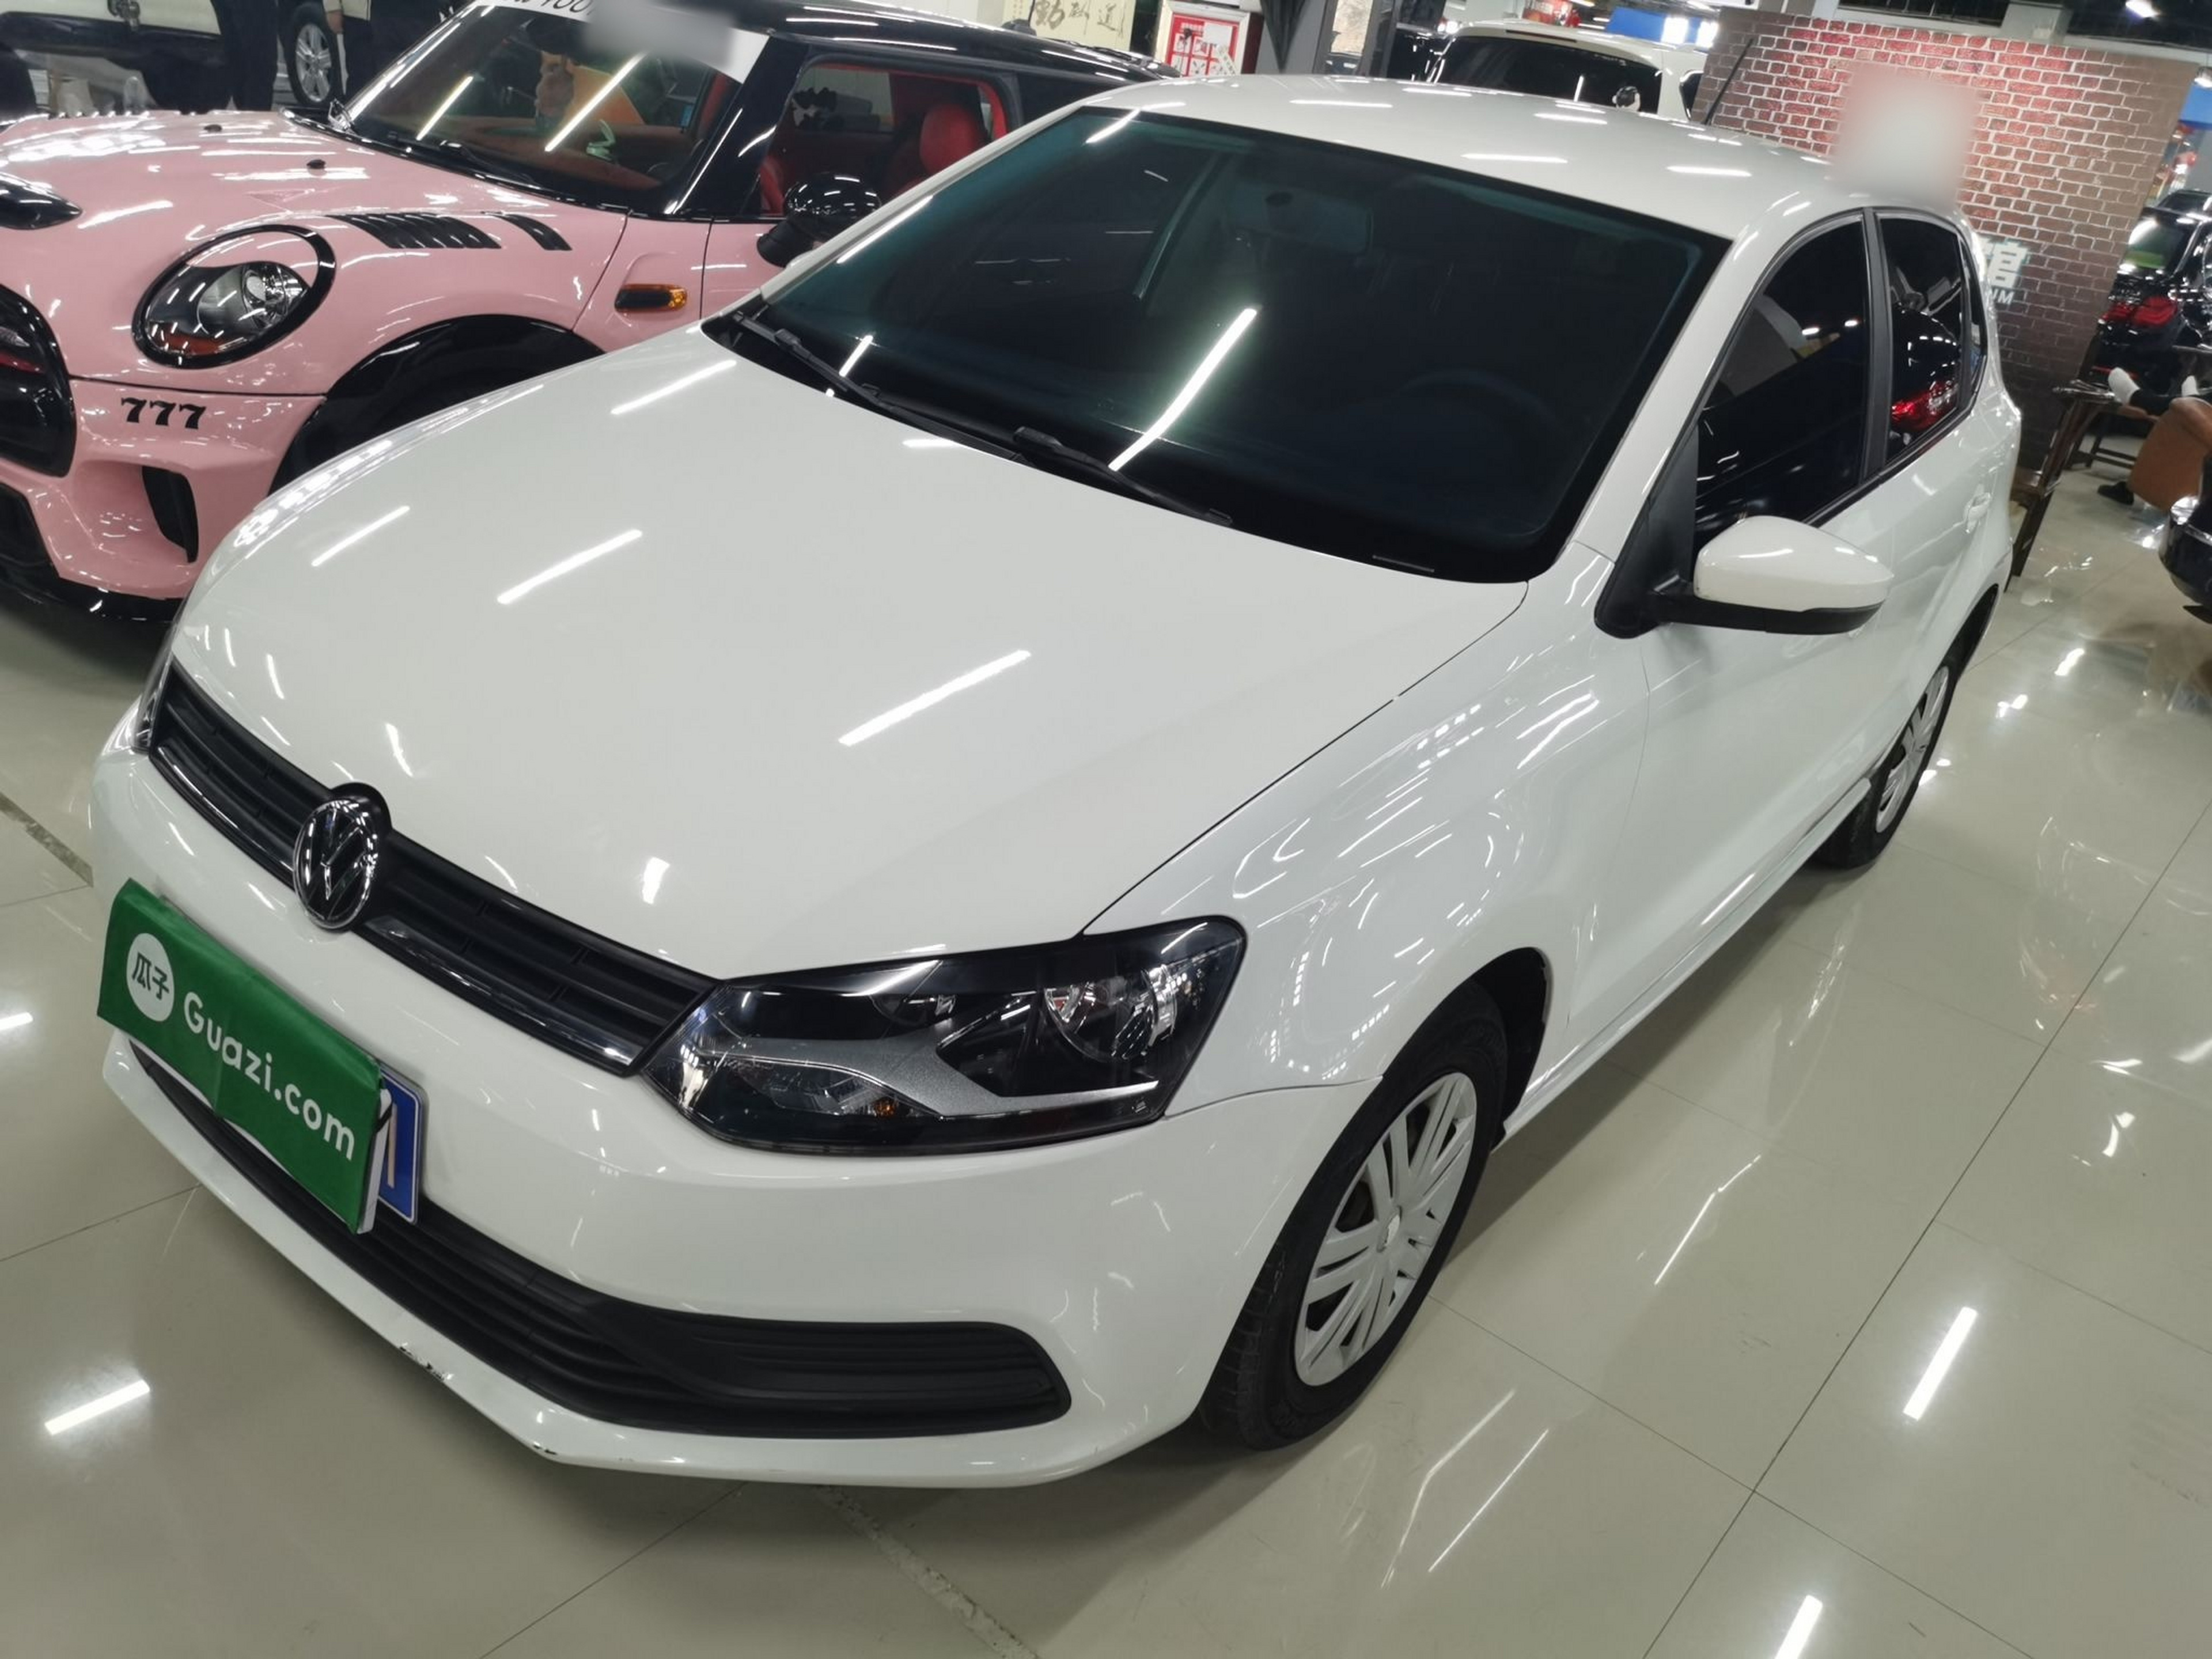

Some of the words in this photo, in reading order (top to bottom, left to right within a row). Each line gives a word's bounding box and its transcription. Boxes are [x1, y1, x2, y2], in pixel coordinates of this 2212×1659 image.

[120, 397, 206, 430] 777
[131, 951, 170, 1001] 瓜子
[183, 991, 355, 1161] Guazi.com
